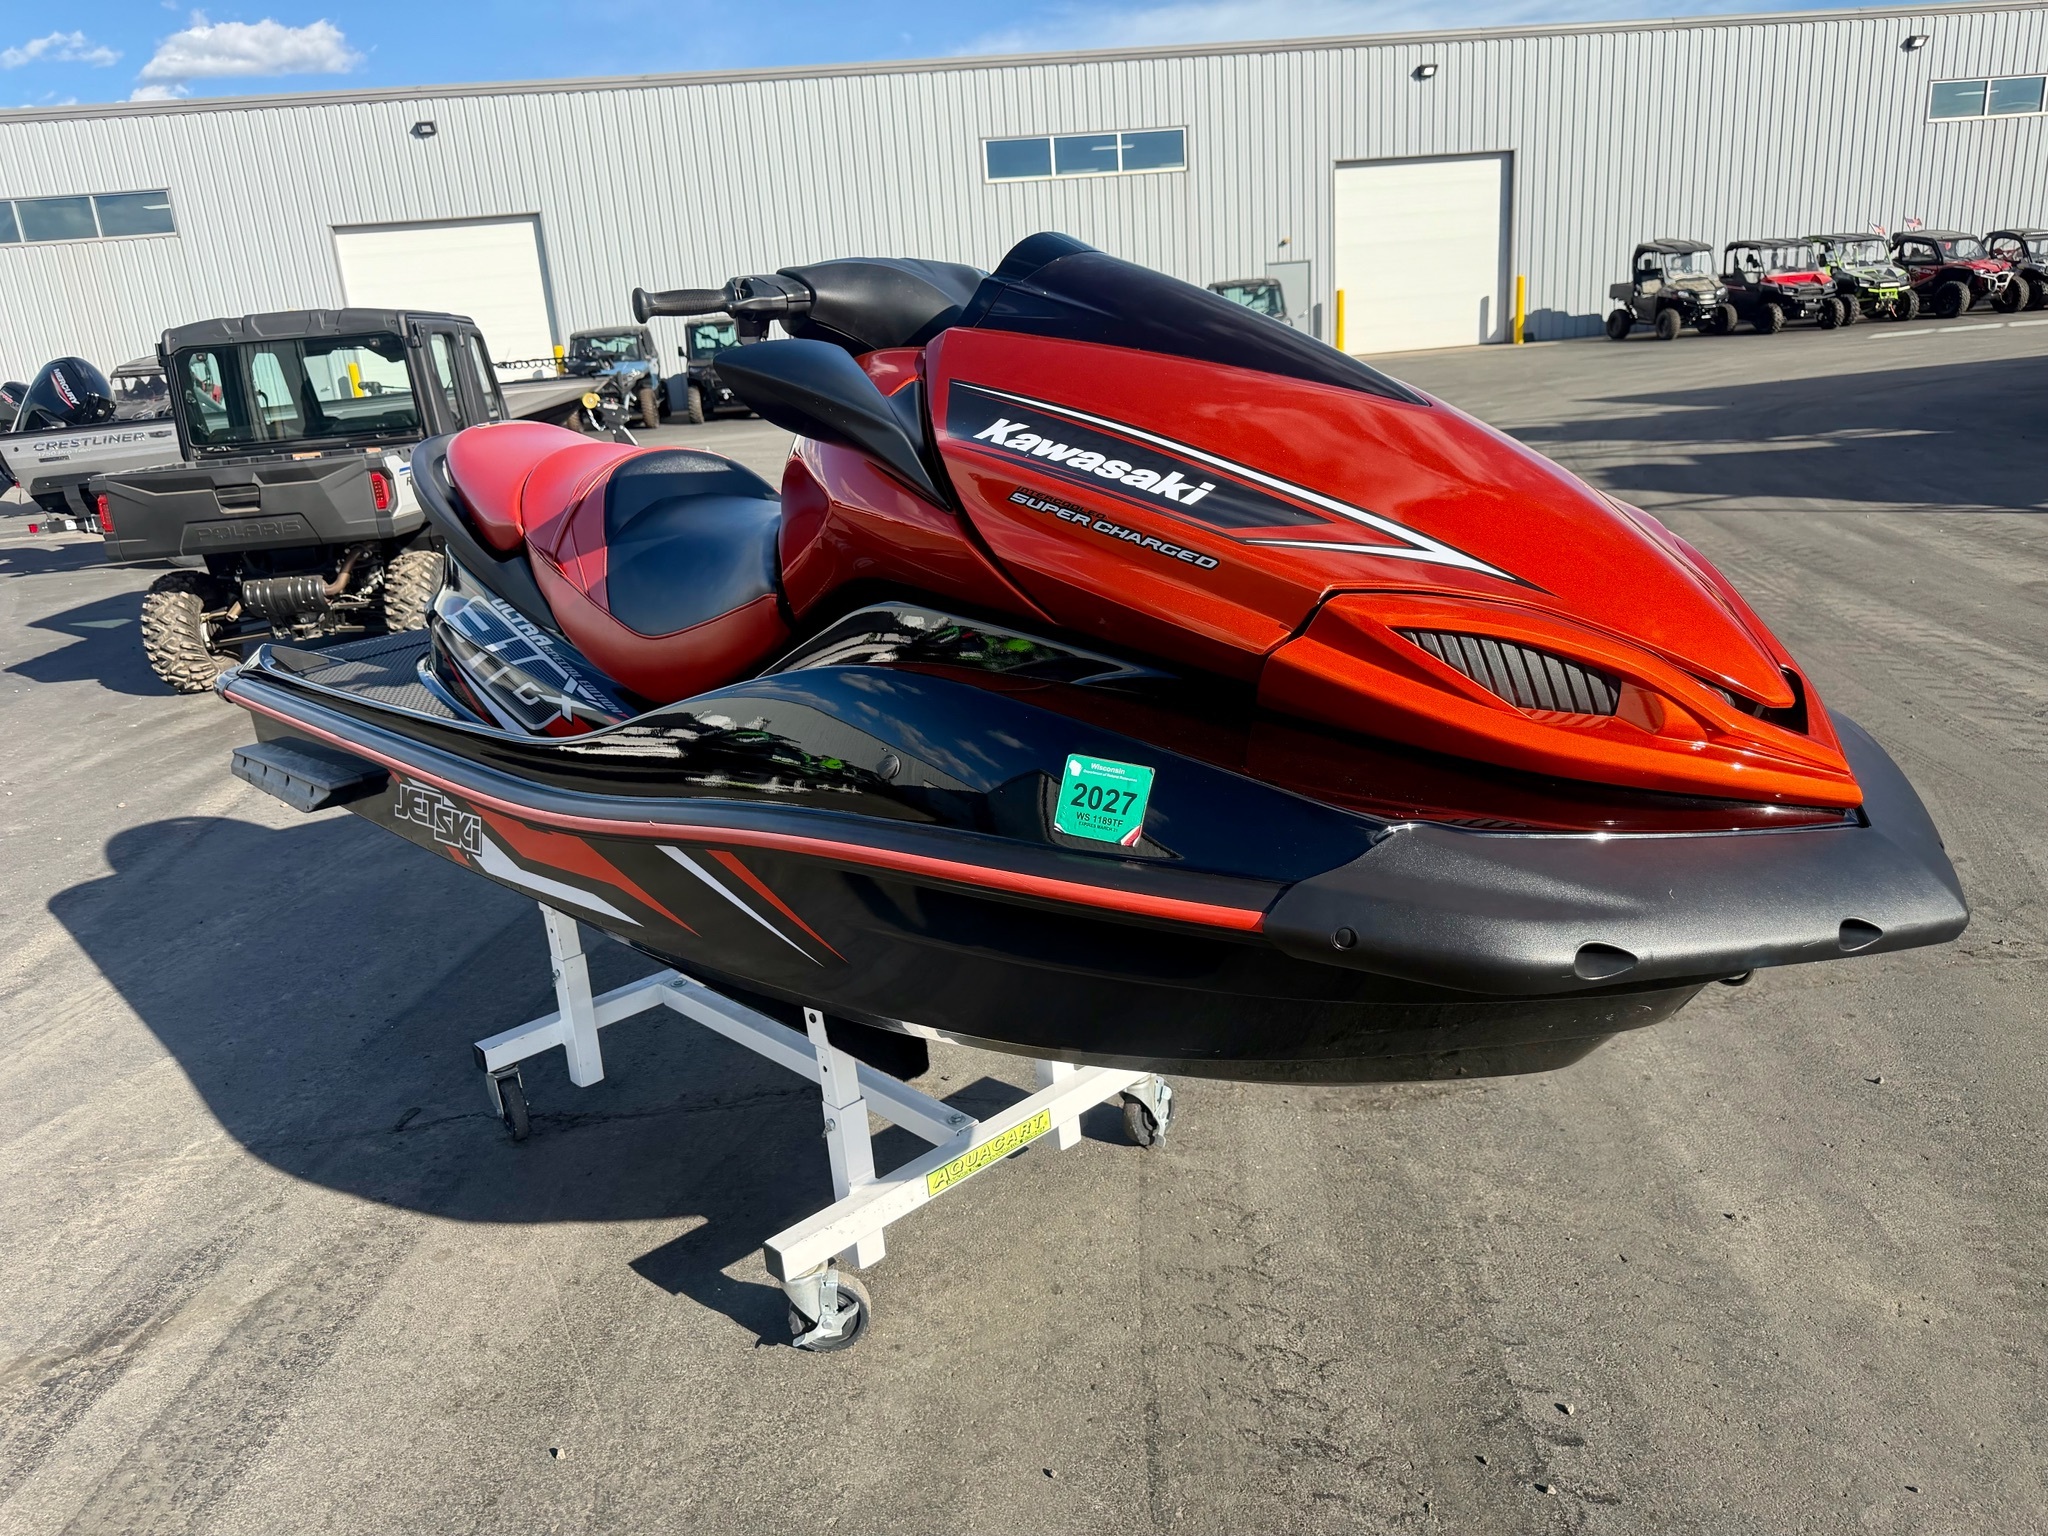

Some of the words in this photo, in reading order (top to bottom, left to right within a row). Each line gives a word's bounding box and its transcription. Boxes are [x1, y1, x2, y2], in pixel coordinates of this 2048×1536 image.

[53, 368, 80, 405] MERCURY
[33, 432, 146, 451] CRESTLINER
[973, 418, 1216, 506] Kawasaki
[1016, 486, 1108, 519] INTERCOOLED
[196, 519, 302, 541] POLARIS
[1009, 492, 1091, 527] SUPER
[1092, 520, 1219, 569] CHARGED
[491, 598, 554, 647] ULTRA
[540, 645, 582, 679] SPECIAL
[579, 680, 623, 713] EDITION
[1091, 763, 1126, 775] Wisconsin
[1070, 783, 1138, 815] 2027
[1076, 811, 1091, 821] WS
[933, 1114, 1044, 1189] AQUACART
